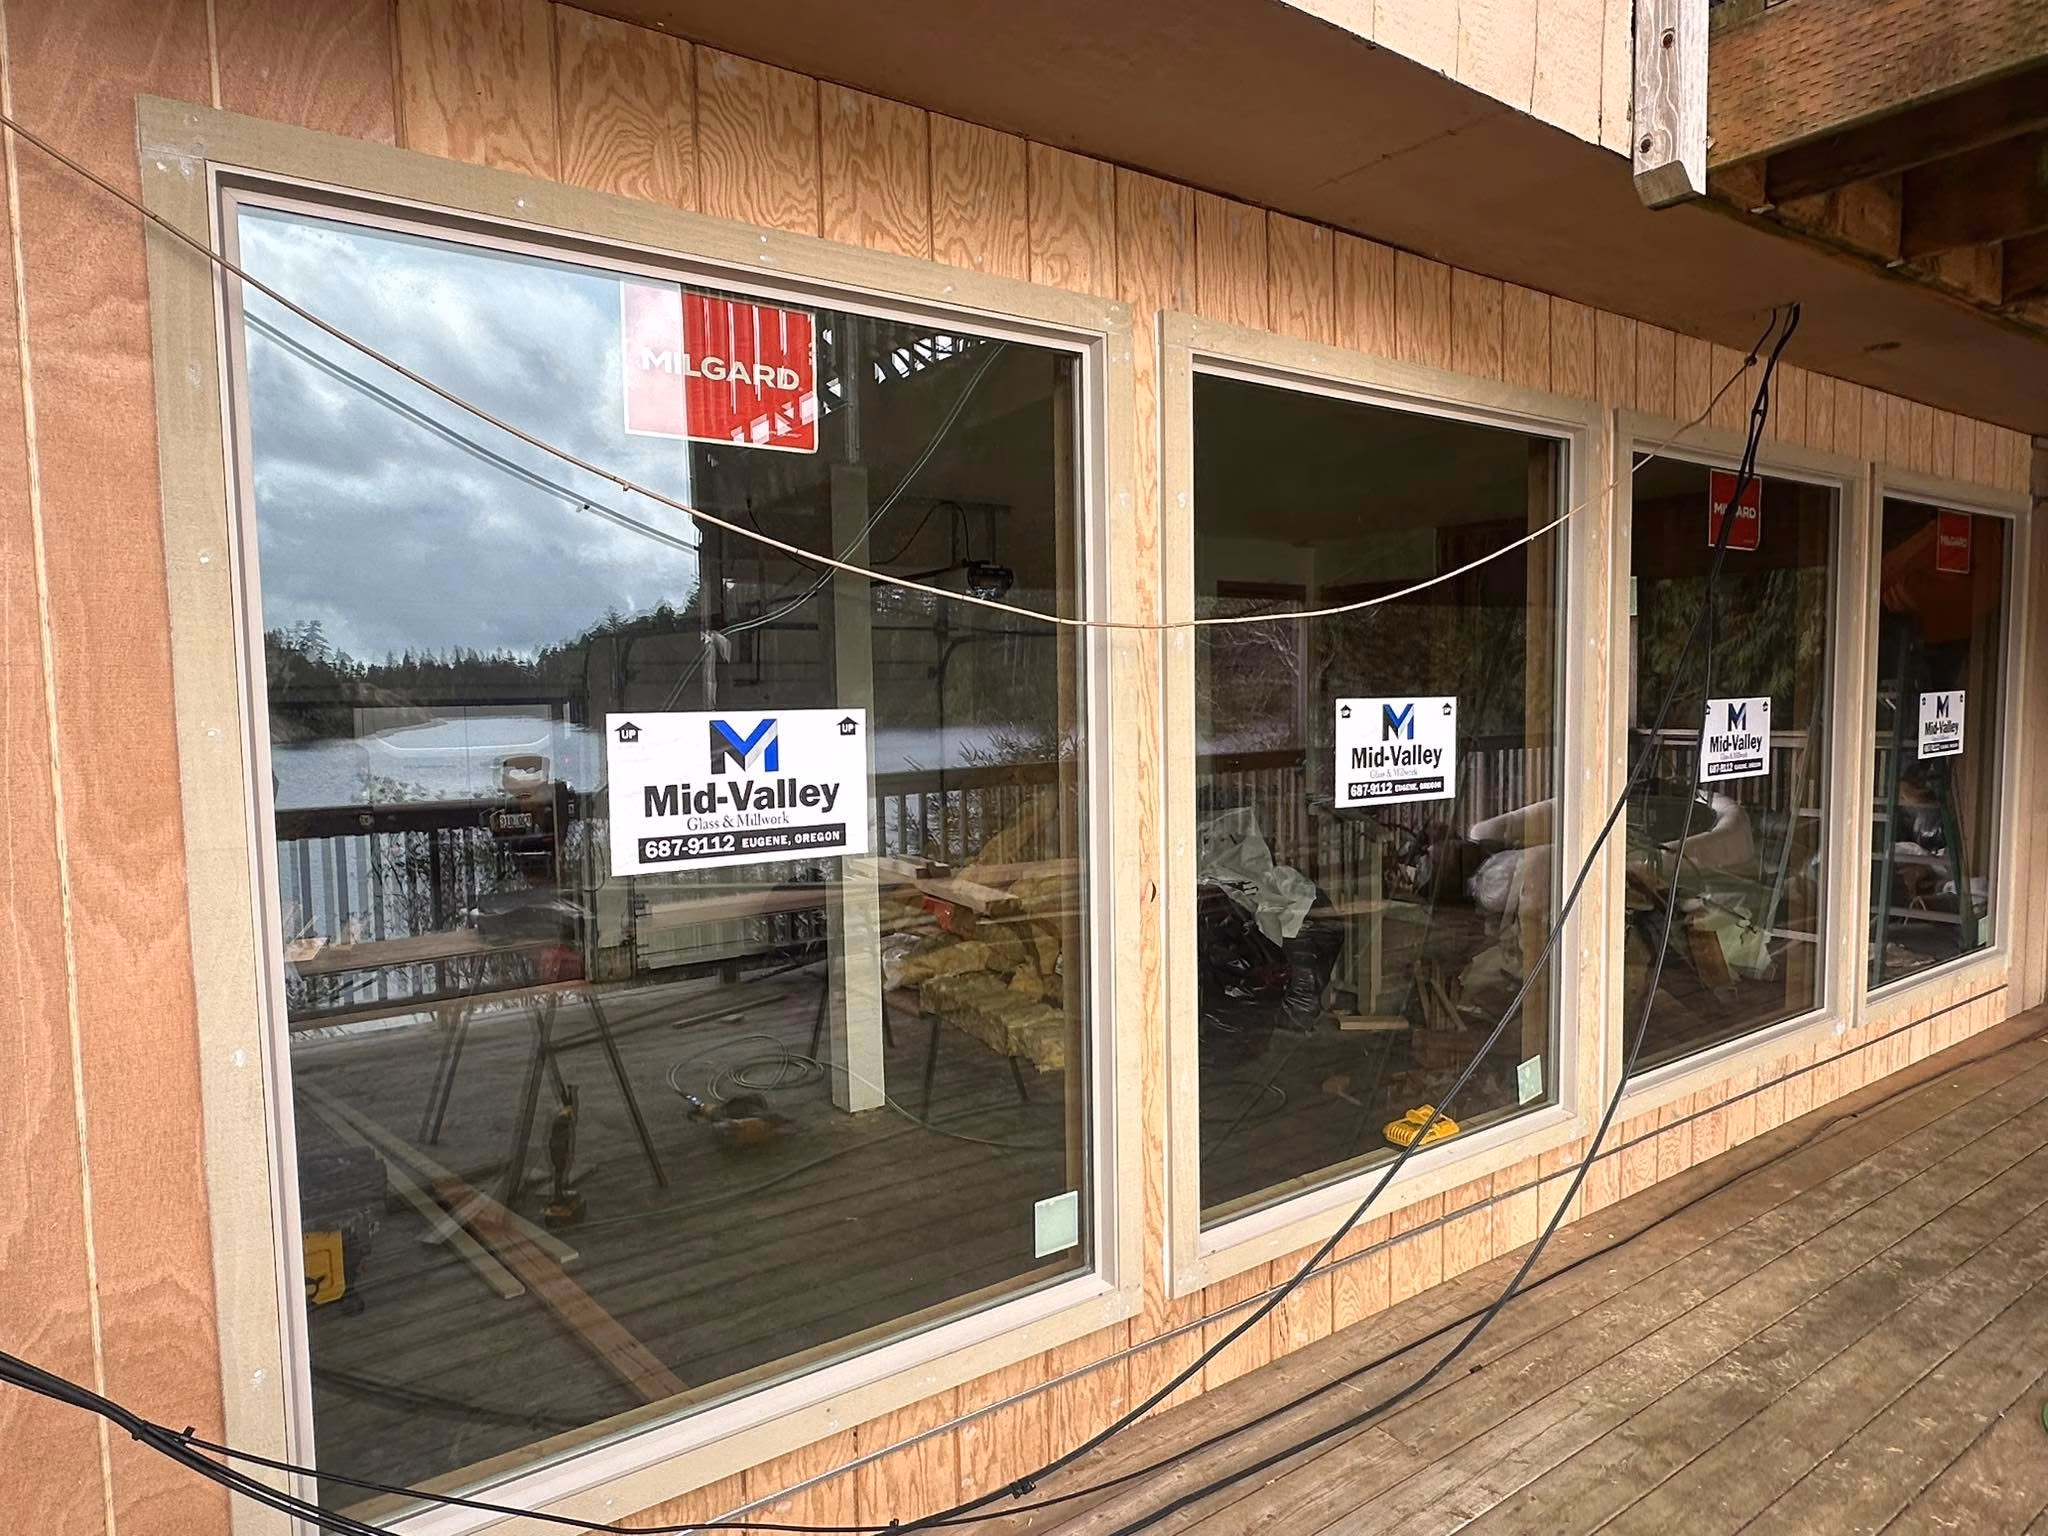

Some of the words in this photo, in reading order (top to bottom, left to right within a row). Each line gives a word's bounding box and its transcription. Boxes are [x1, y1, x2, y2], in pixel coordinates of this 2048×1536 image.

[639, 349, 800, 391] MILGARD
[1713, 502, 1757, 519] MIARD
[620, 729, 637, 740] UP
[841, 722, 855, 733] UP
[1709, 733, 1763, 753] Mid-Valley
[1351, 744, 1443, 769] Mid-Valley
[644, 777, 840, 818] Mid-Valley
[1350, 782, 1393, 798] 687-9112
[686, 815, 720, 832] Glass
[723, 815, 734, 828] &
[736, 811, 790, 827] Millwork
[644, 834, 736, 859] 687-9112
[741, 834, 792, 849] EUGENE,
[794, 830, 840, 844] OREGON
